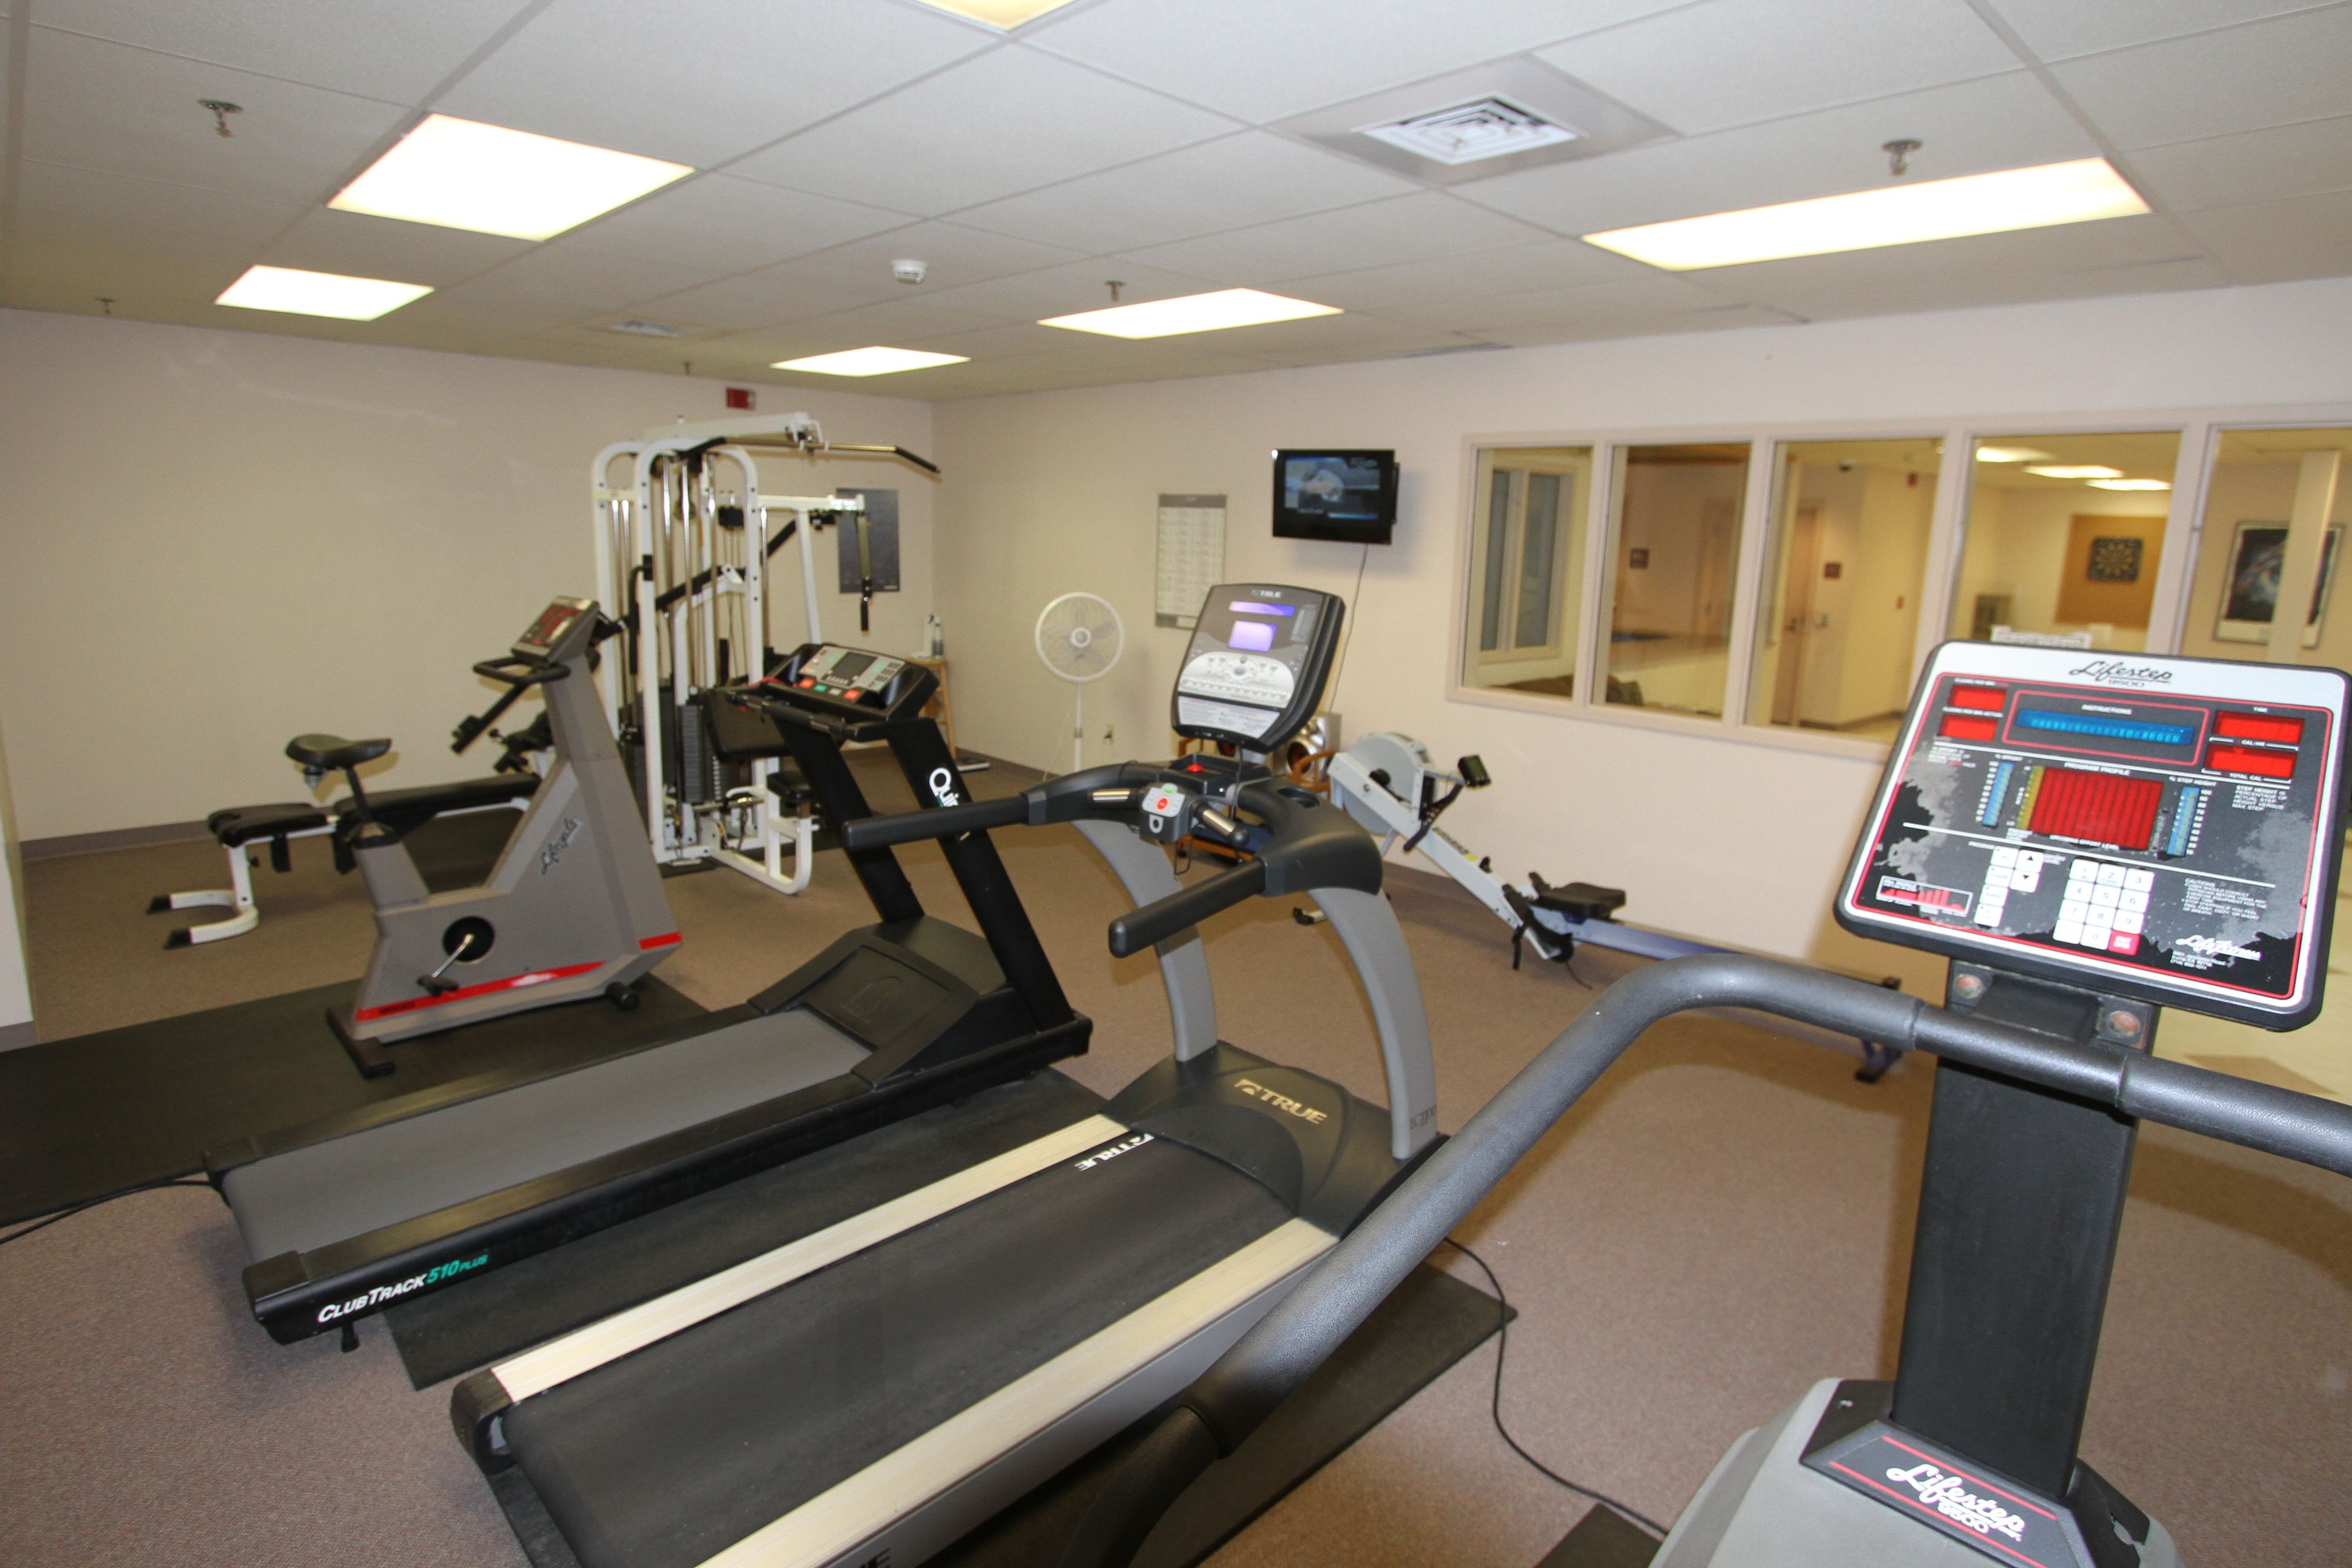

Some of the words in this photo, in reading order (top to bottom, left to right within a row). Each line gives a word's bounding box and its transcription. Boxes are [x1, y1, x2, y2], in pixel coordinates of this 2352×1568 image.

[2068, 660, 2173, 682] Lifestep
[1259, 1089, 1328, 1125] TRUE
[1074, 1143, 1136, 1171] TRUE
[426, 1260, 460, 1284] 510
[459, 1254, 489, 1272] PLUS
[1886, 1463, 2026, 1539] Lifestep
[1937, 1501, 1989, 1534] 9500
